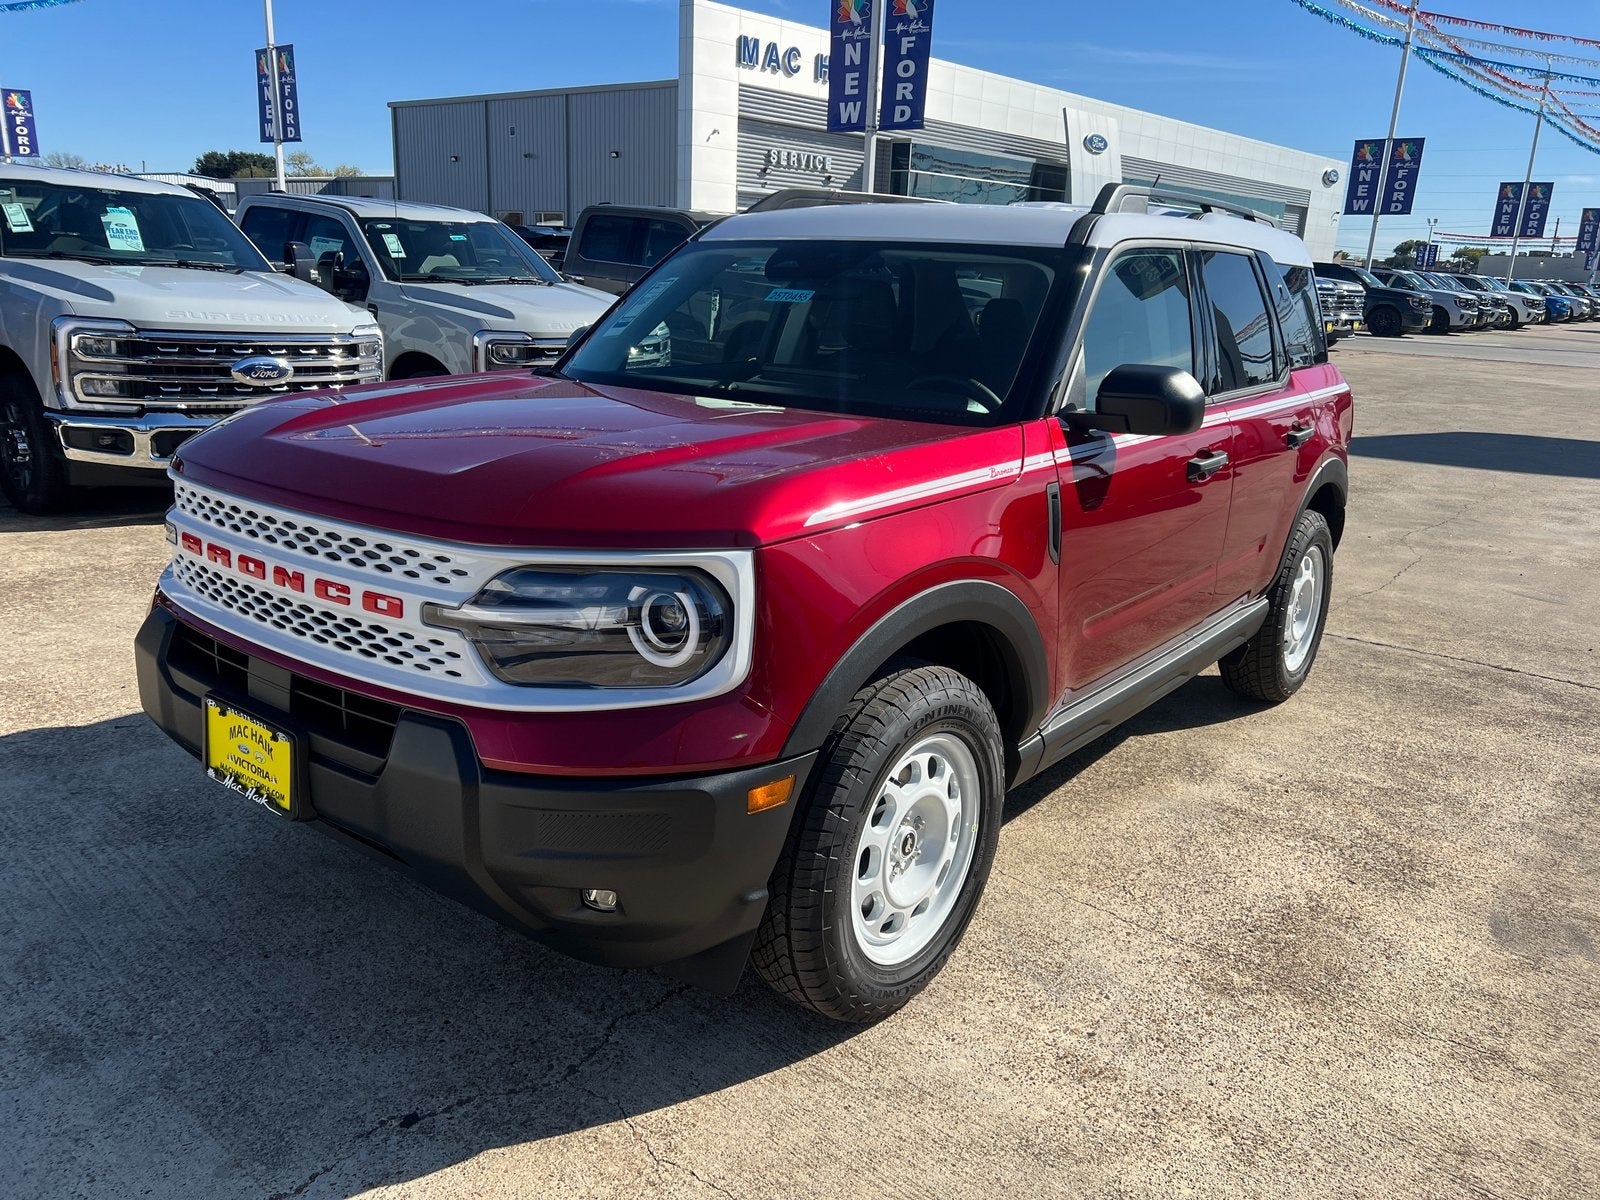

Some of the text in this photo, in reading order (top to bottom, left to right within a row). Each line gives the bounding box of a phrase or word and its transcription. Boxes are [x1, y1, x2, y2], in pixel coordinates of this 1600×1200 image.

[738, 34, 802, 76] MAC
[839, 42, 862, 124] NEW
[893, 36, 916, 123] FORD
[264, 86, 274, 138] NEW
[284, 84, 295, 138] FORD
[15, 116, 31, 155] FORD
[770, 149, 833, 171] SERVICE
[1352, 169, 1372, 211] NEW
[1389, 169, 1409, 212] FORD
[1497, 204, 1513, 235] NEW
[1526, 204, 1541, 236] FORD
[1580, 224, 1594, 249] NEW
[251, 364, 279, 379] Ford
[988, 467, 1015, 479] Bronco
[181, 531, 404, 620] BRONCO
[229, 724, 274, 761] MAC HAIK
[232, 754, 271, 781] VICTORIA
